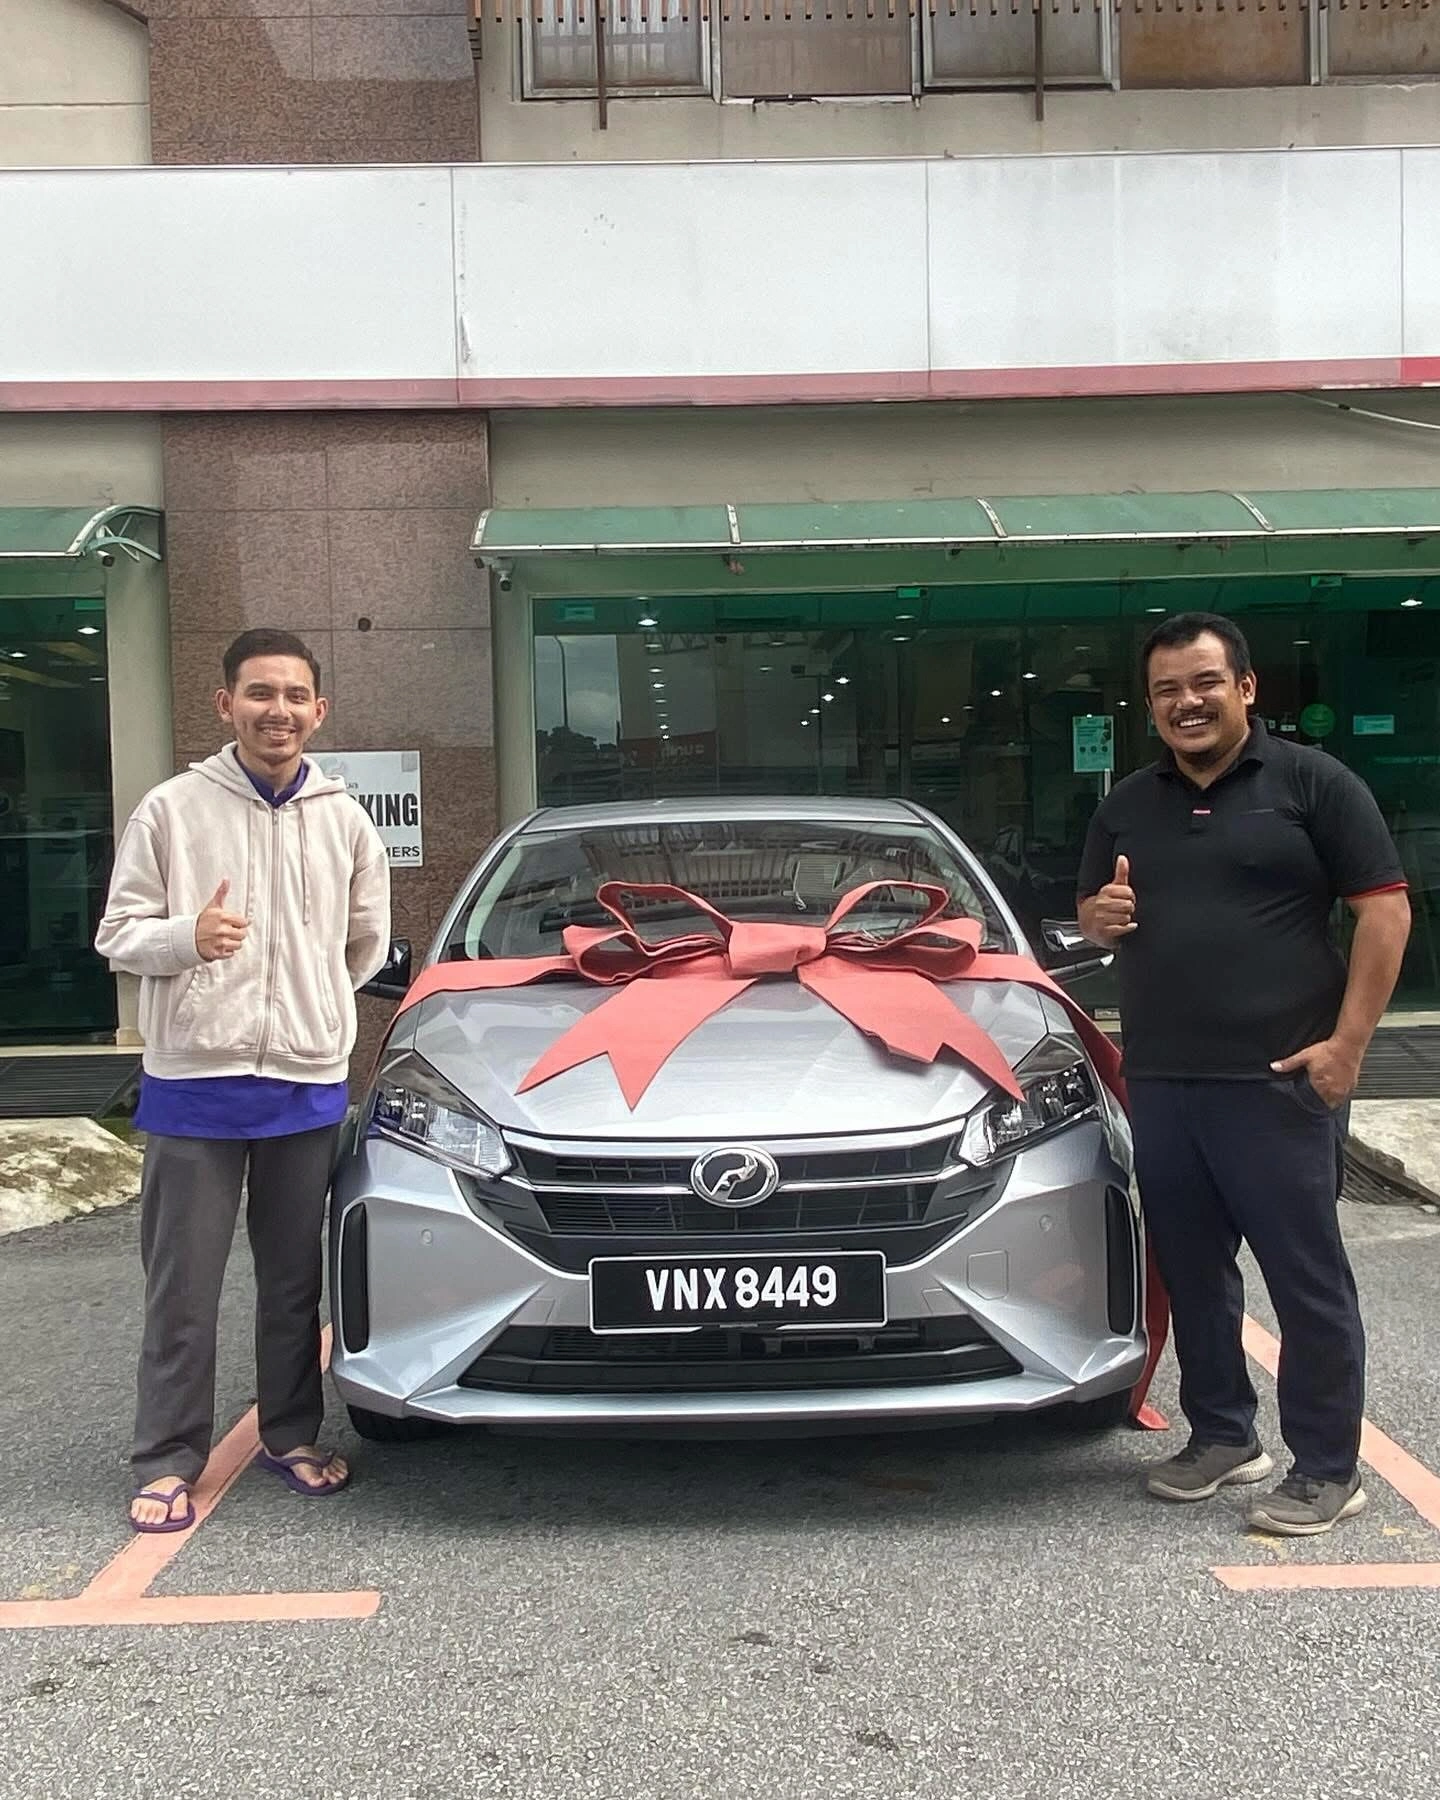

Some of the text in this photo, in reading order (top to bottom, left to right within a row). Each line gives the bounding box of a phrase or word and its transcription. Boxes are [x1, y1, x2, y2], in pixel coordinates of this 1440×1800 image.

[351, 793, 418, 826] KING
[645, 1265, 837, 1311] VNX 8449
